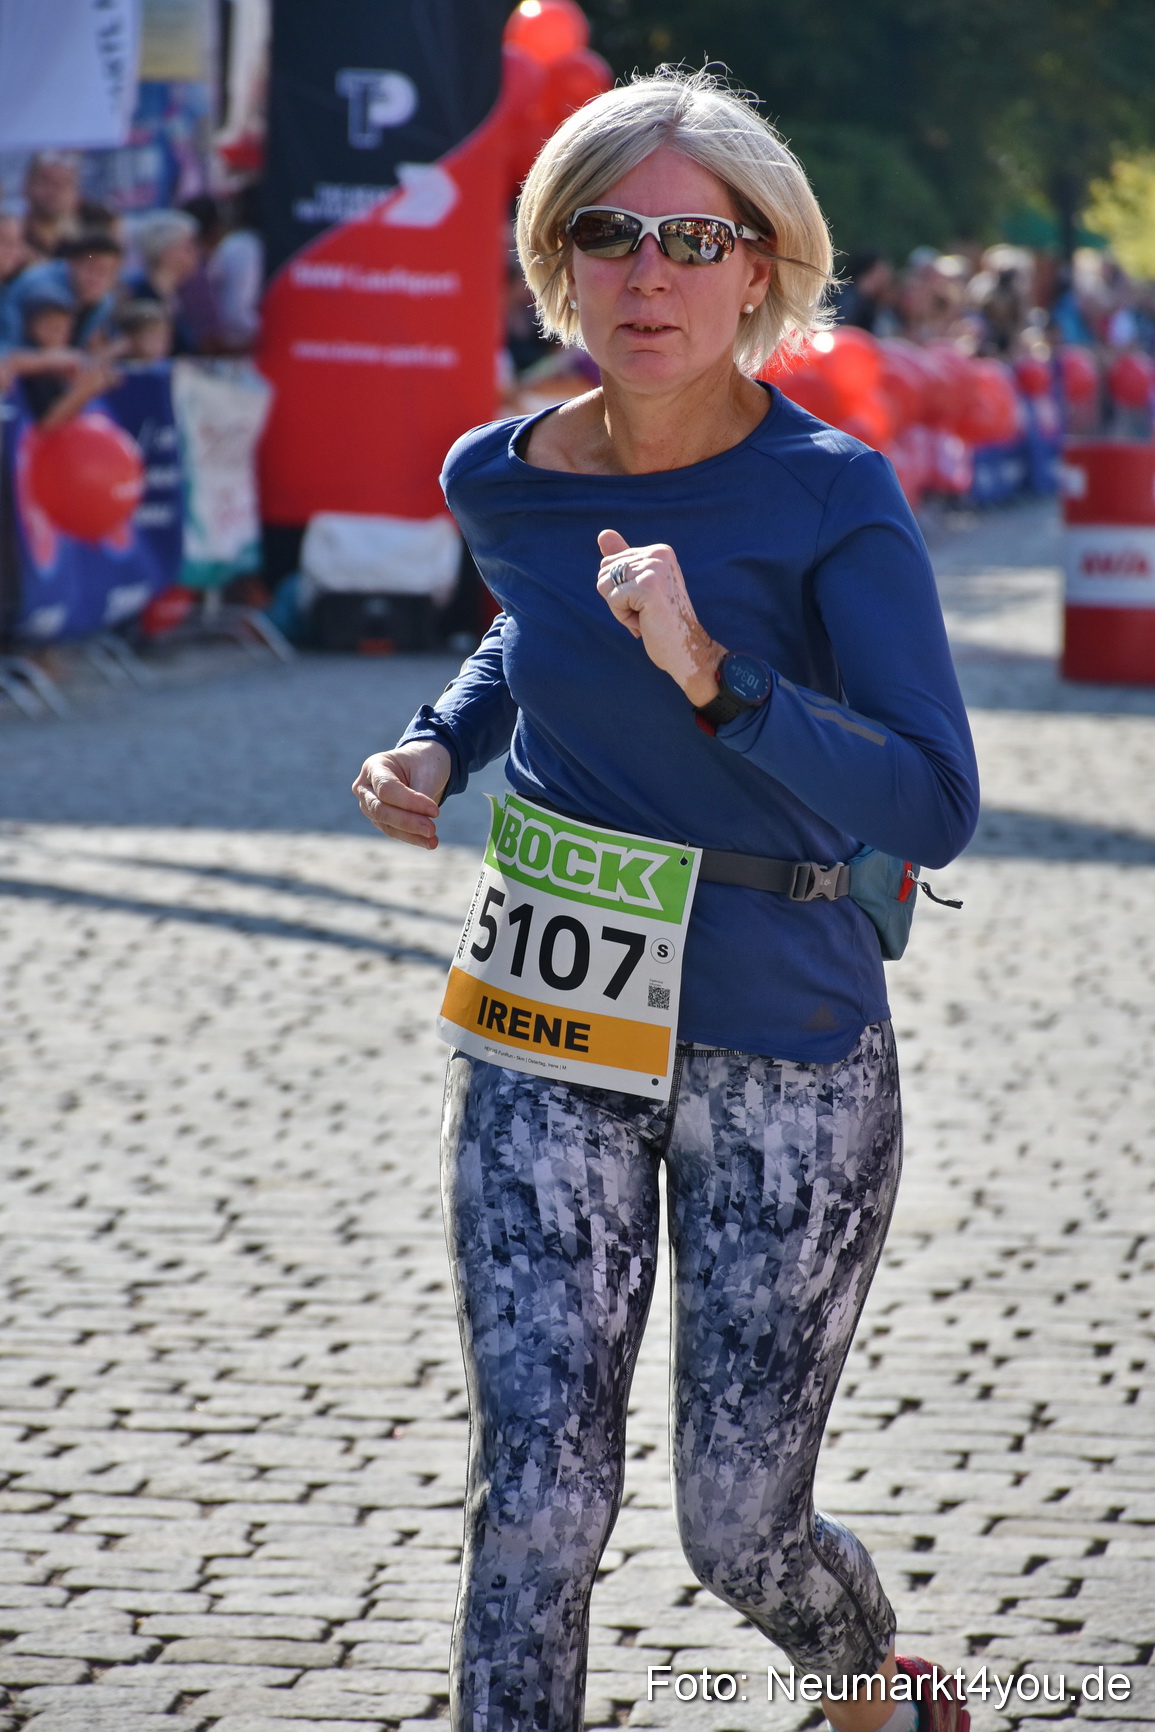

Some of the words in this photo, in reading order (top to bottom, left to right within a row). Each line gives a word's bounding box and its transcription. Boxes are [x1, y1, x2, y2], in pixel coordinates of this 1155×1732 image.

[494, 805, 670, 911] BOCK
[470, 886, 646, 1001] 5107
[477, 995, 591, 1053] IRENE
